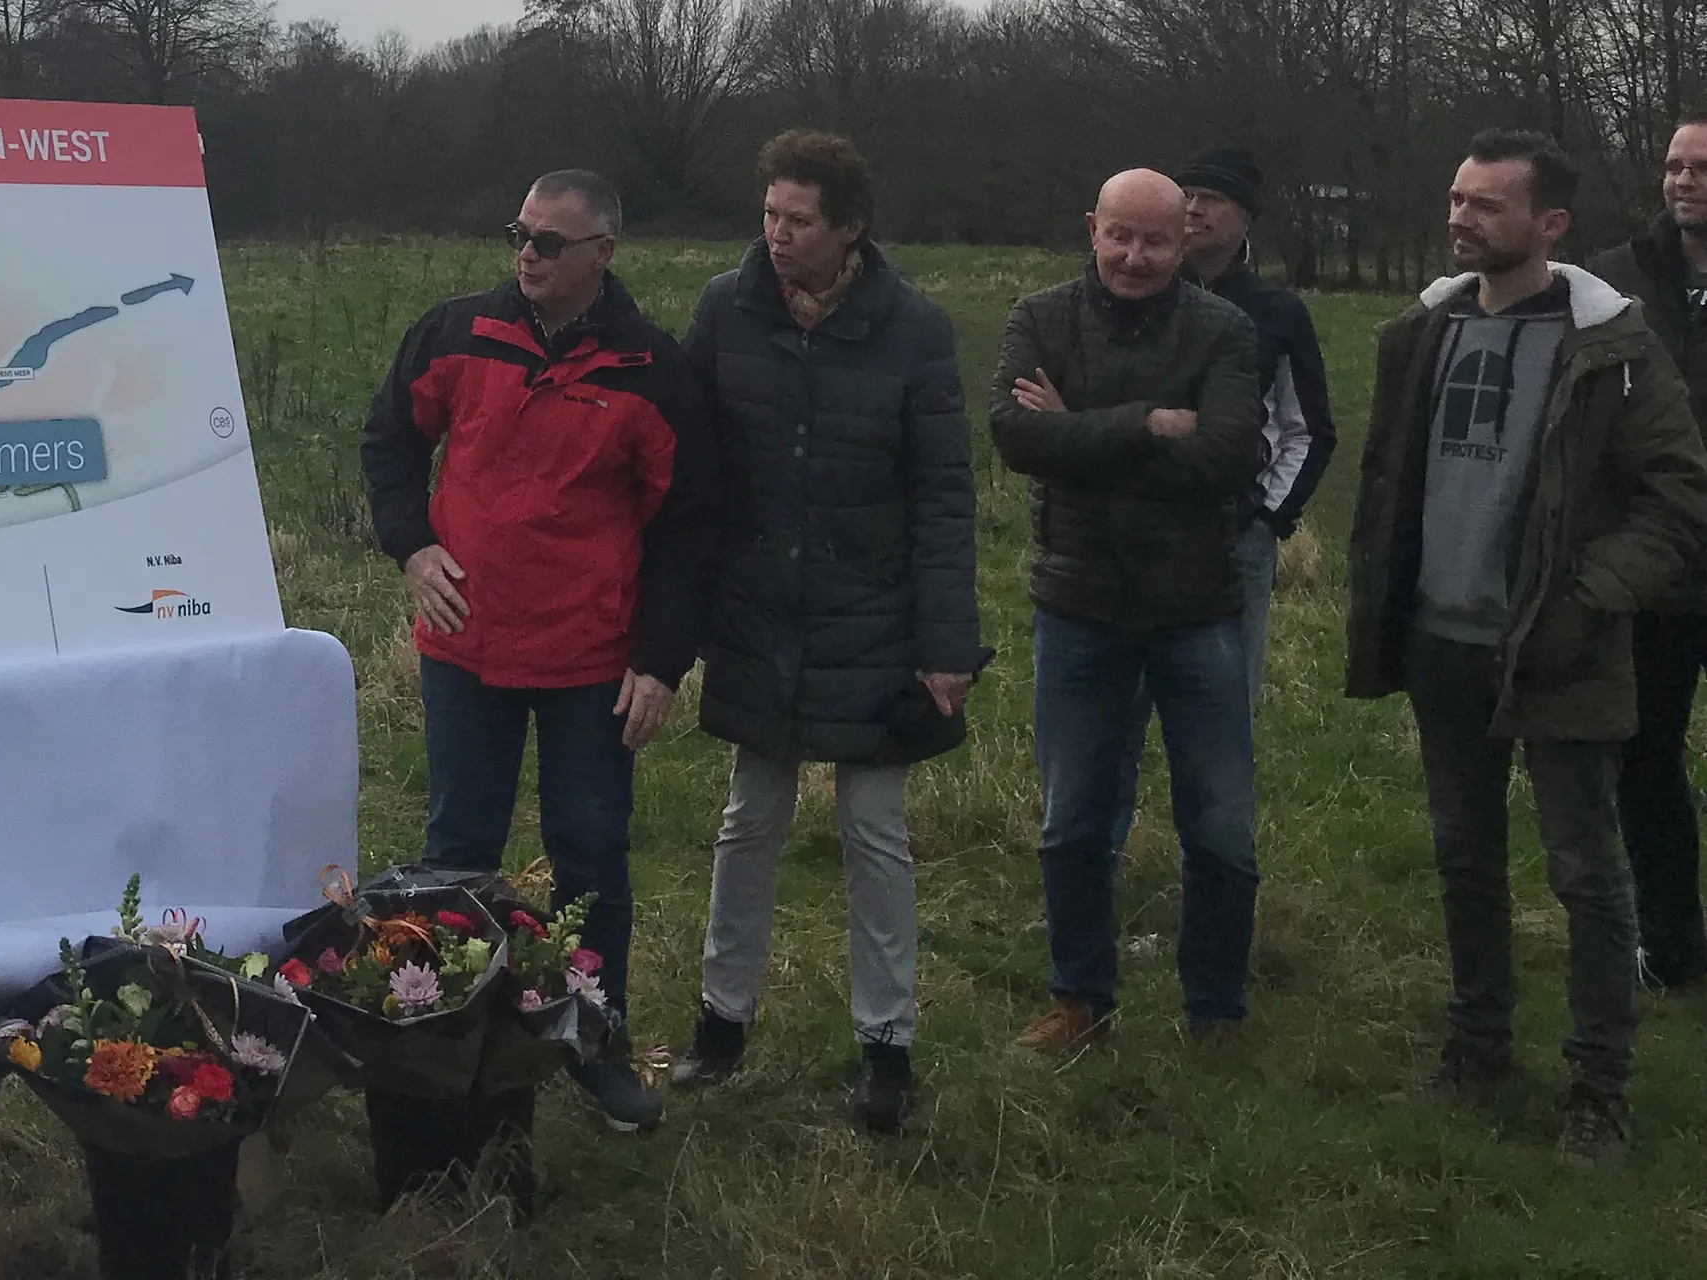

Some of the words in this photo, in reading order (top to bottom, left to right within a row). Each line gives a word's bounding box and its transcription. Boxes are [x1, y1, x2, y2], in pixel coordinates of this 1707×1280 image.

[1440, 441, 1508, 464] PROTEST
[146, 555, 164, 567] N.V.
[164, 554, 183, 565] Niba
[157, 605, 175, 619] nv
[177, 598, 211, 617] niba
